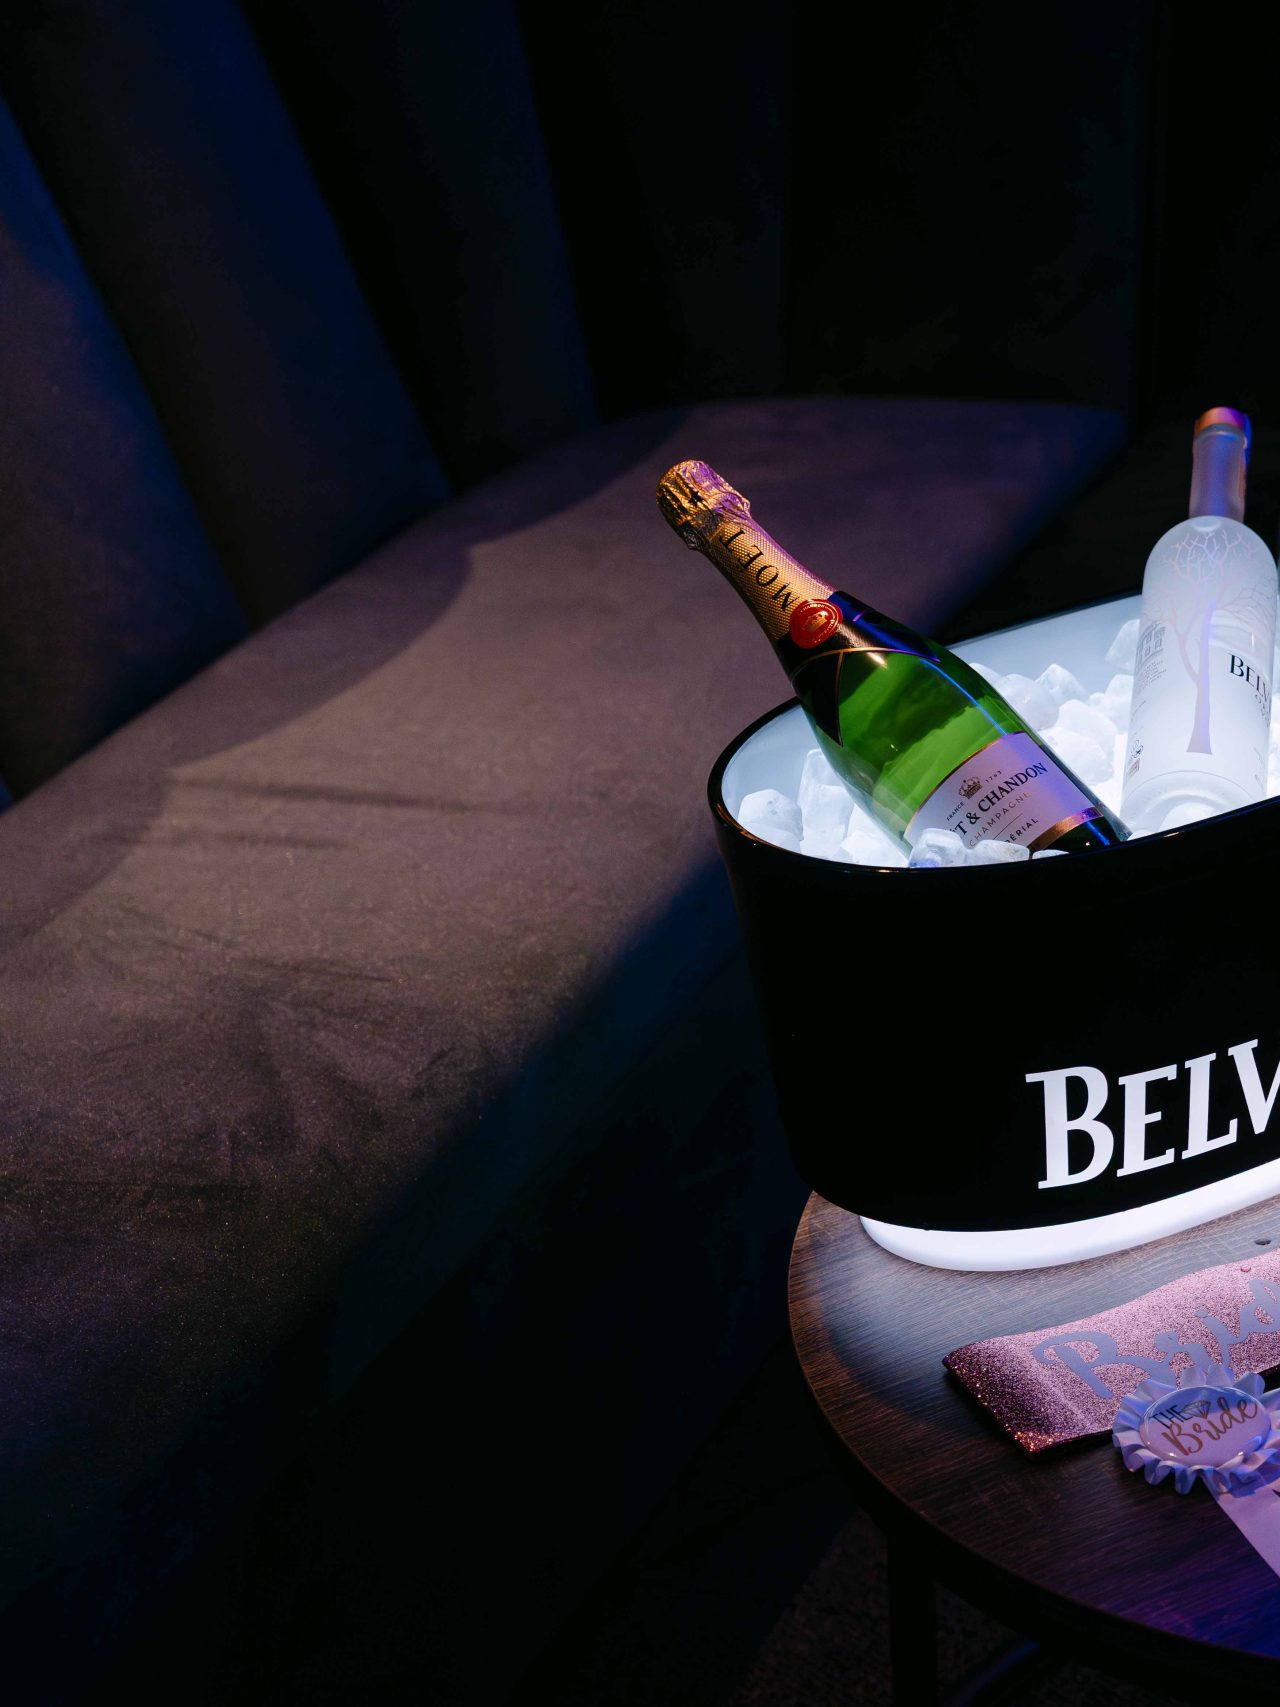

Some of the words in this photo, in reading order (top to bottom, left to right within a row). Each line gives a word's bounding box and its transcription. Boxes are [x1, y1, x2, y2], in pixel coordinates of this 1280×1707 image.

[946, 801, 965, 821] FRANCE
[965, 811, 982, 826] &
[977, 762, 1048, 812] CHANDON
[969, 792, 1031, 847] CHAMPAGNE
[1149, 1404, 1194, 1430] THE
[1161, 1396, 1258, 1456] Bride
